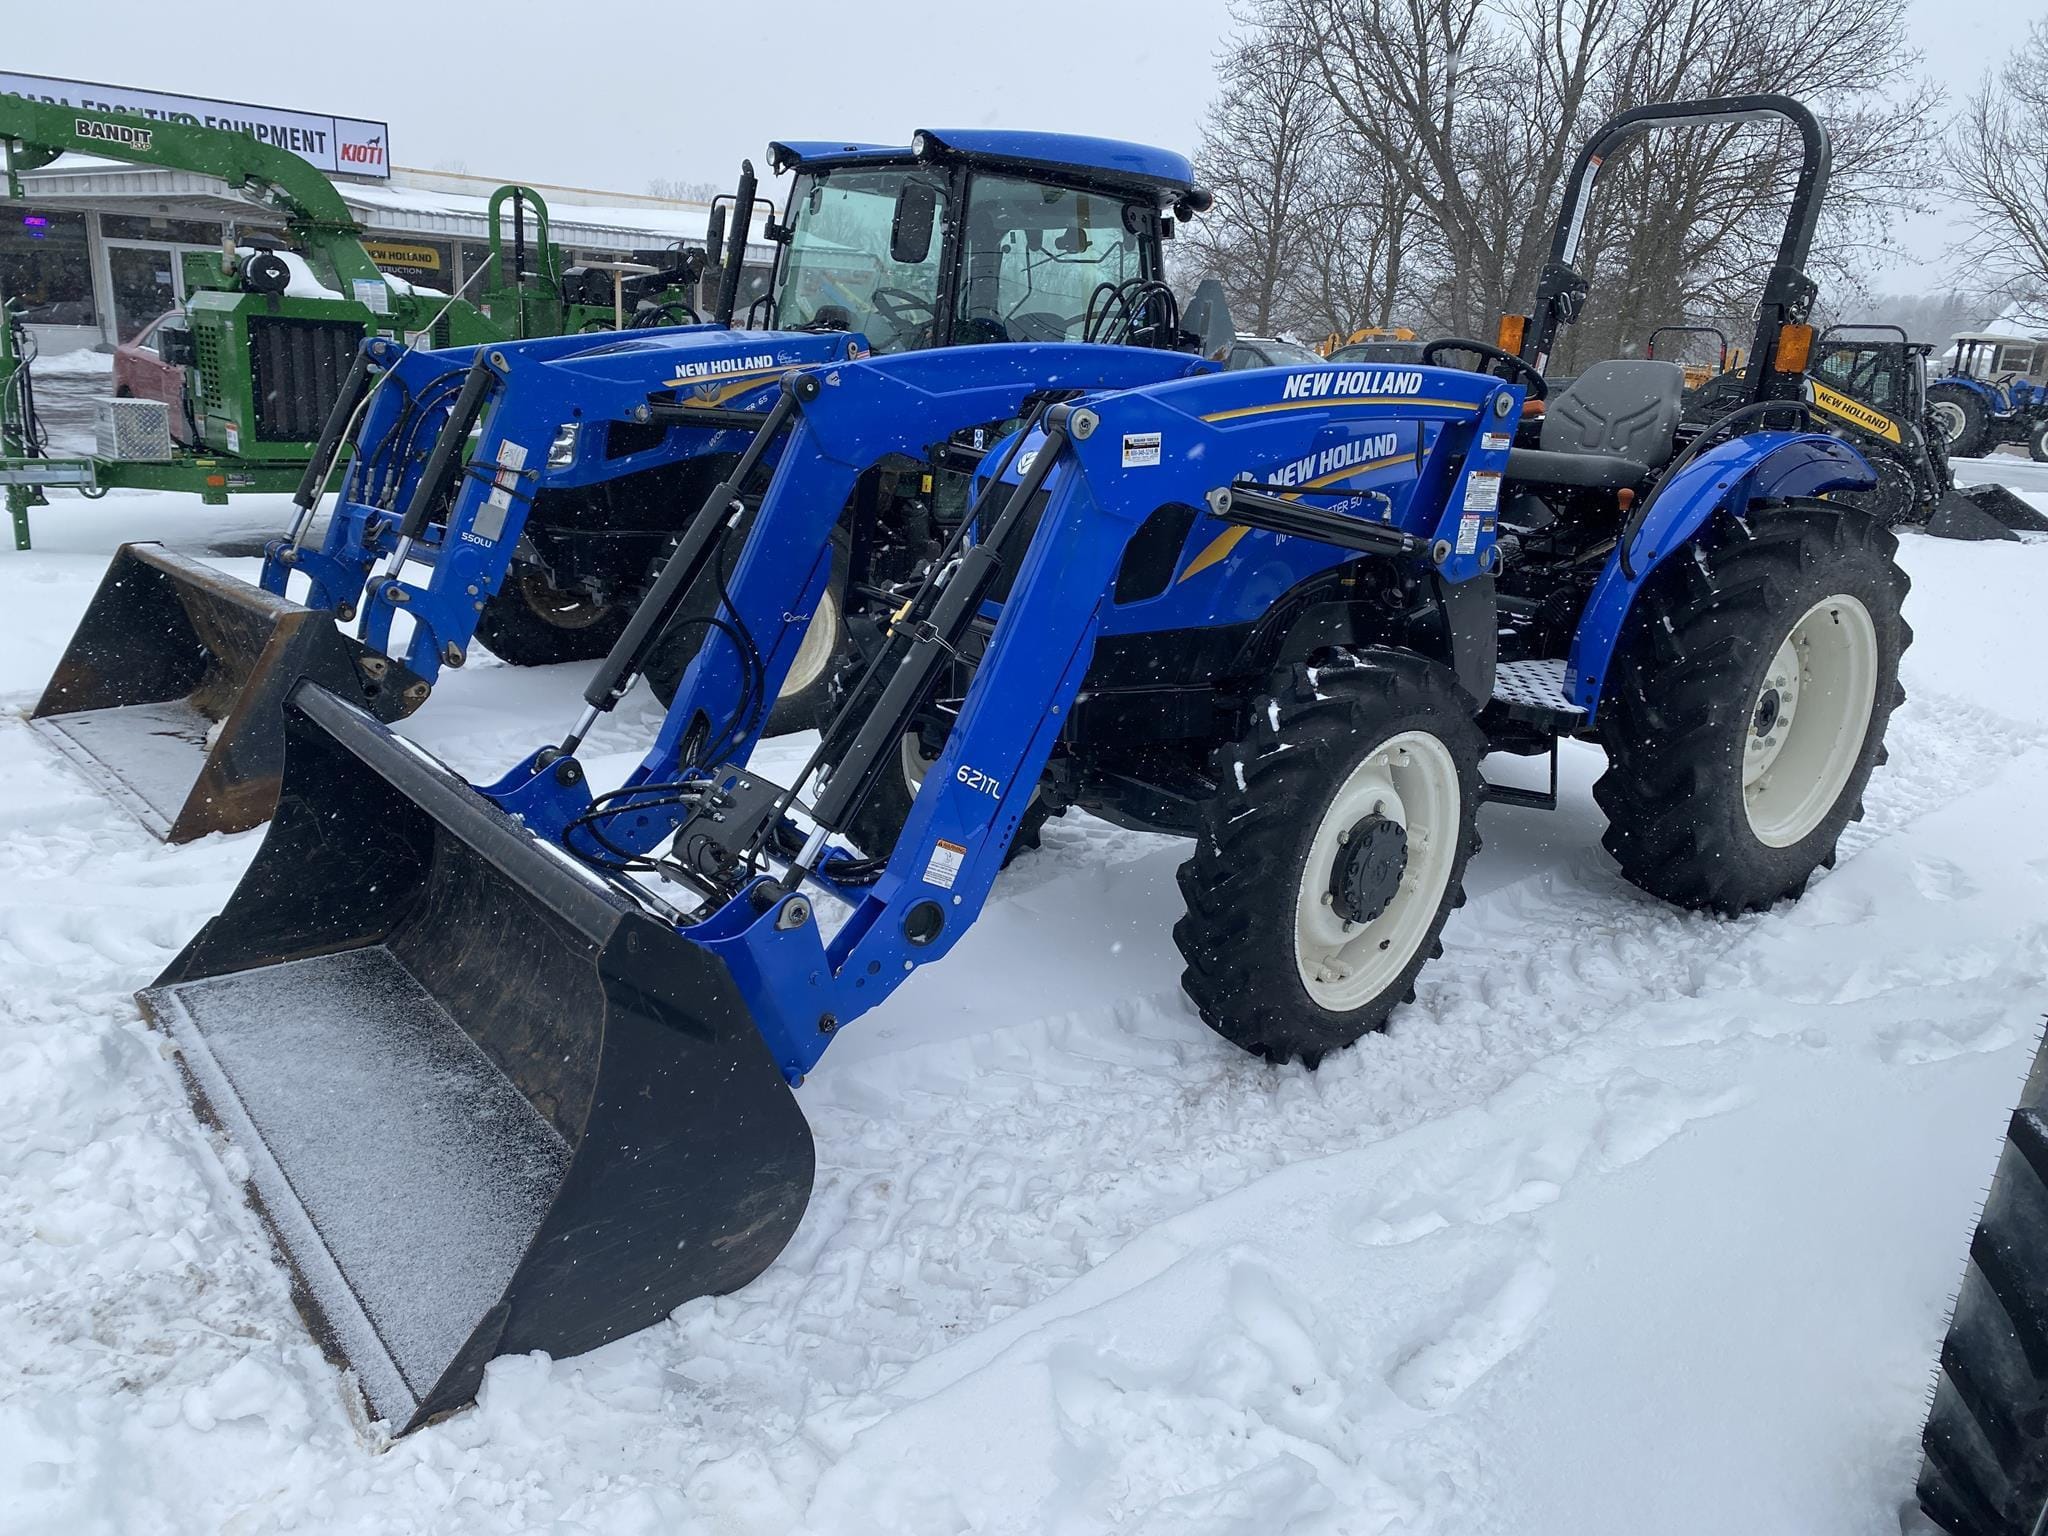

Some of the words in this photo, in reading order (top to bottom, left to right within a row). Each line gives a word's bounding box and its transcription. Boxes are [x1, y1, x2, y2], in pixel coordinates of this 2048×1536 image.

[76, 120, 152, 144] BANDIT
[341, 143, 383, 165] KIOTI
[388, 251, 432, 263] HOLLAND
[675, 361, 707, 378] NEW
[711, 354, 773, 374] HOLLAND
[1282, 372, 1335, 399] NEW
[1333, 371, 1423, 395] HOLLAND
[758, 394, 768, 405] 65
[1819, 391, 1842, 408] NEW
[1842, 403, 1887, 430] HOLLAND
[1267, 453, 1317, 495] NEW
[1319, 433, 1398, 475] HOLLAND
[461, 532, 493, 549] 550LU
